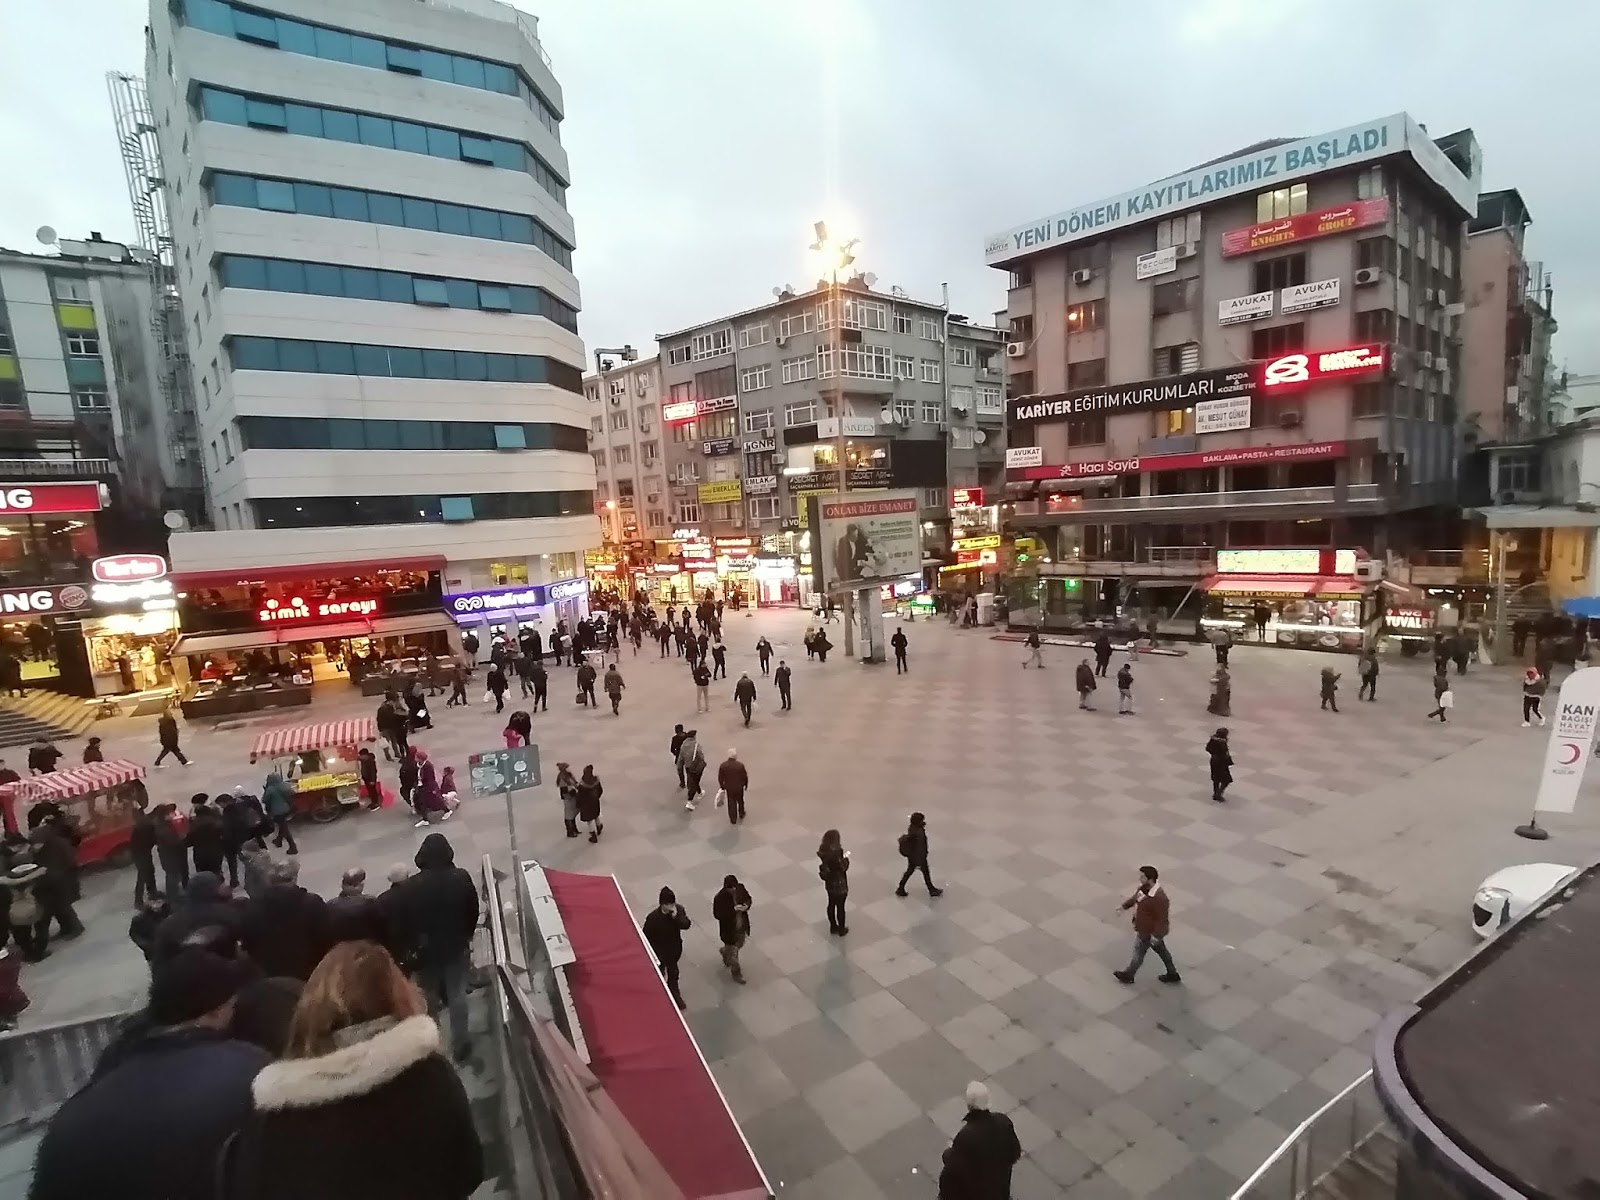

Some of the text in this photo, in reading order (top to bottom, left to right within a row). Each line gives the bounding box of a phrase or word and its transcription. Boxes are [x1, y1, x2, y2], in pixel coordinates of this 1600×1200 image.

[1013, 125, 1388, 250] YENİ DÖNEM KAYITLARIMIZ BAŞLADI
[1251, 230, 1296, 247] KNIGHTS
[1317, 216, 1356, 233] GROUP
[1295, 280, 1339, 296] AVUKAT
[1231, 294, 1273, 309] AVUKAT
[1225, 372, 1249, 381] MODA
[1016, 378, 1214, 420] KARİYER EĞİTİM KURUMLARI
[751, 440, 774, 449] GNR
[1013, 448, 1040, 456] AVUKAT
[1203, 445, 1333, 463] BAKLAVA PASTA RESTAURANT
[1079, 458, 1140, 474] Hacı Sayid
[745, 477, 769, 486] EMLAK
[794, 474, 820, 484] SECRET
[850, 471, 874, 480] SECRET
[826, 500, 914, 517] ONLAR BİZE EMANET
[0, 590, 54, 613] NG
[63, 593, 84, 604] KING
[1208, 590, 1243, 598] MEYDAN
[1256, 591, 1305, 599] LOKANTASI
[260, 596, 377, 621] simit sarayı
[1386, 615, 1435, 629] TUVALET
[1563, 703, 1594, 716] KAN
[1560, 722, 1590, 731] HAYAT
